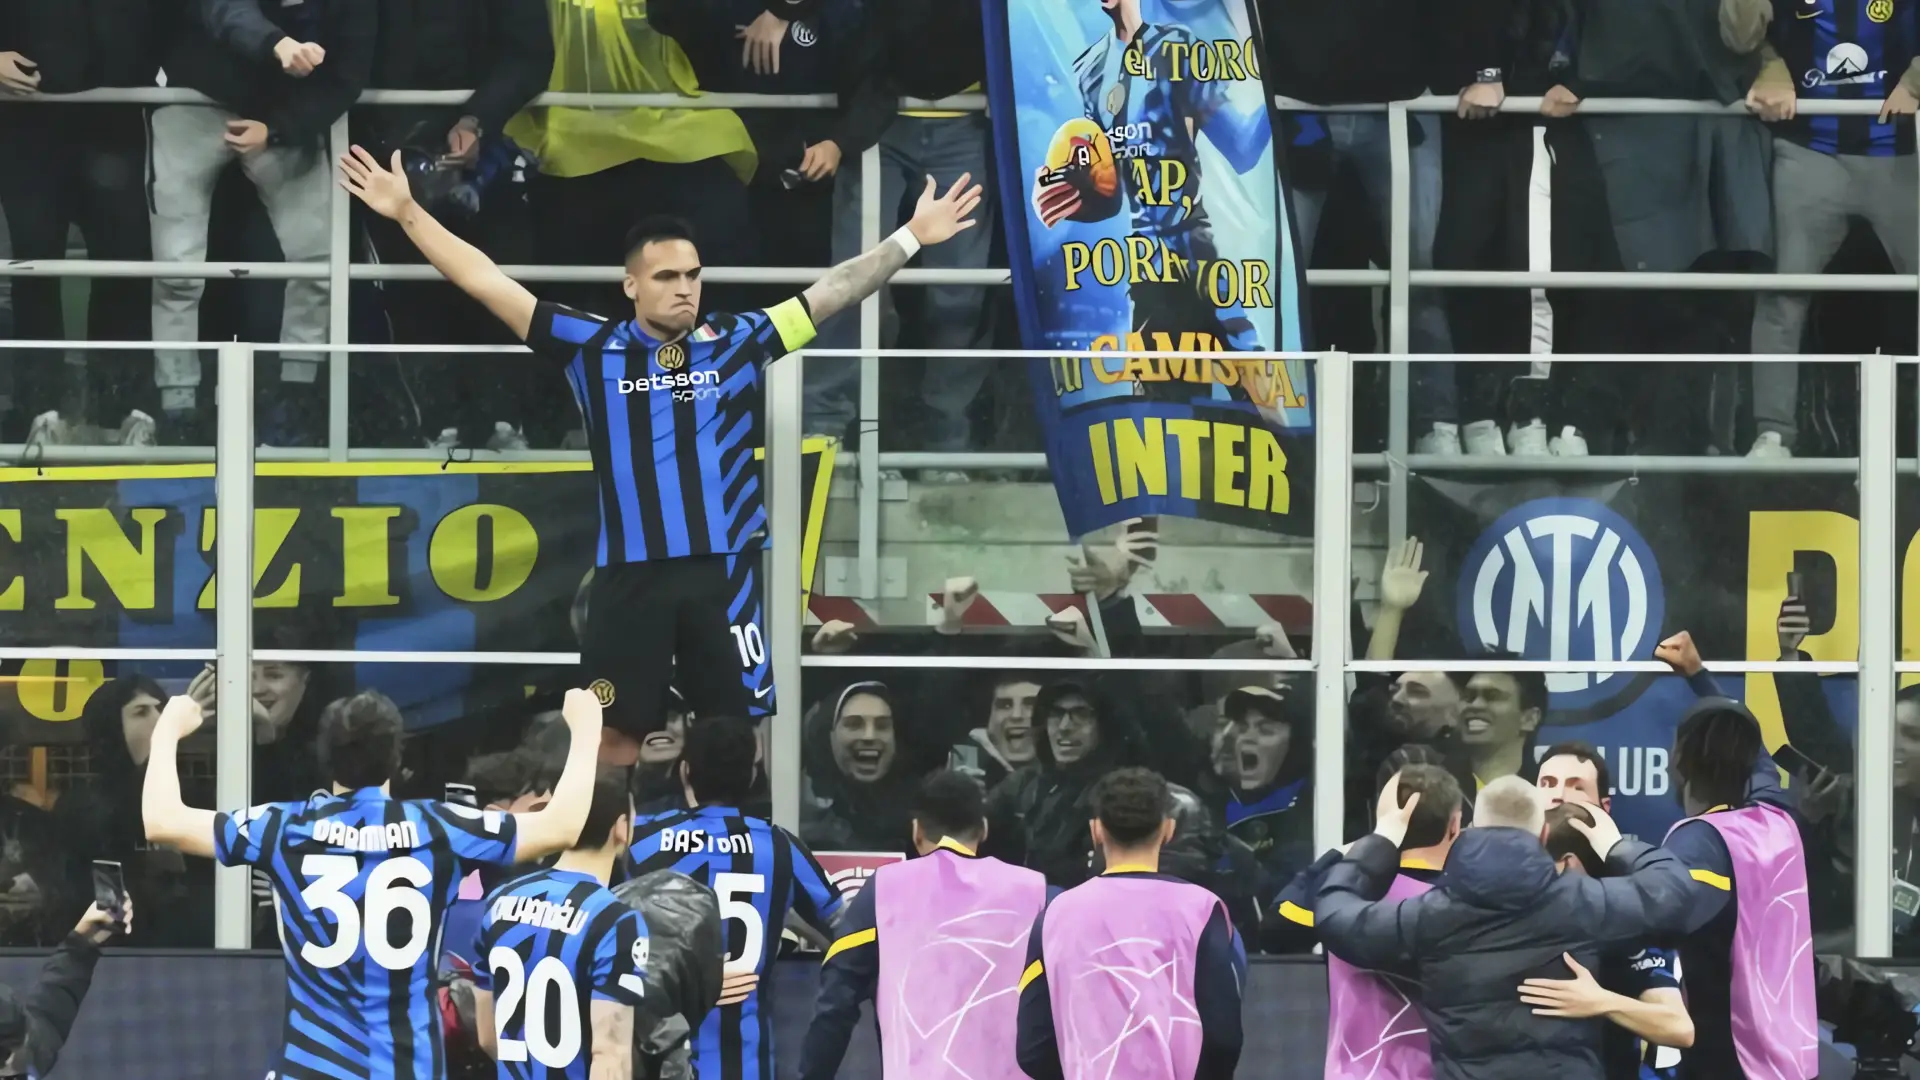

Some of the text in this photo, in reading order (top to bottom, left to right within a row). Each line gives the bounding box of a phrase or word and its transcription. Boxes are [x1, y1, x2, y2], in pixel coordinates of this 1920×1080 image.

[617, 369, 720, 395] betsson
[1088, 416, 1290, 516] INTER
[729, 621, 766, 668] 10
[300, 854, 434, 971] 36
[488, 945, 582, 1069] 20
